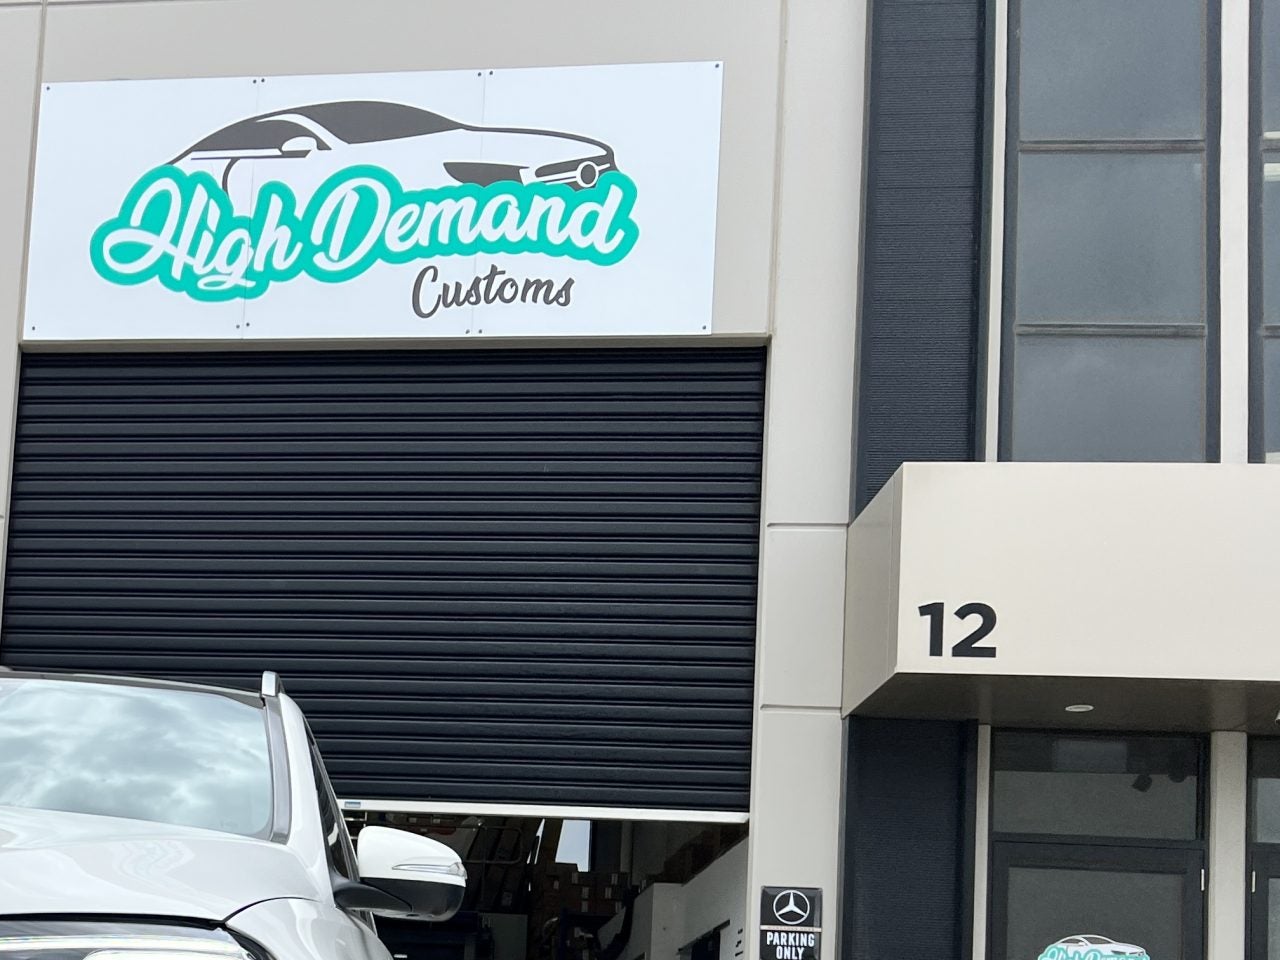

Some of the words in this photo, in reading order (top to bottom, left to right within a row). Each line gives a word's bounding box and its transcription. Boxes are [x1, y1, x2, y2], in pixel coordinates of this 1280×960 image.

[102, 176, 303, 288] High
[311, 178, 624, 272] Demand
[411, 264, 575, 318] Customs
[918, 602, 997, 658] 12
[766, 931, 815, 947] PARKING
[776, 946, 805, 960] ONLY
